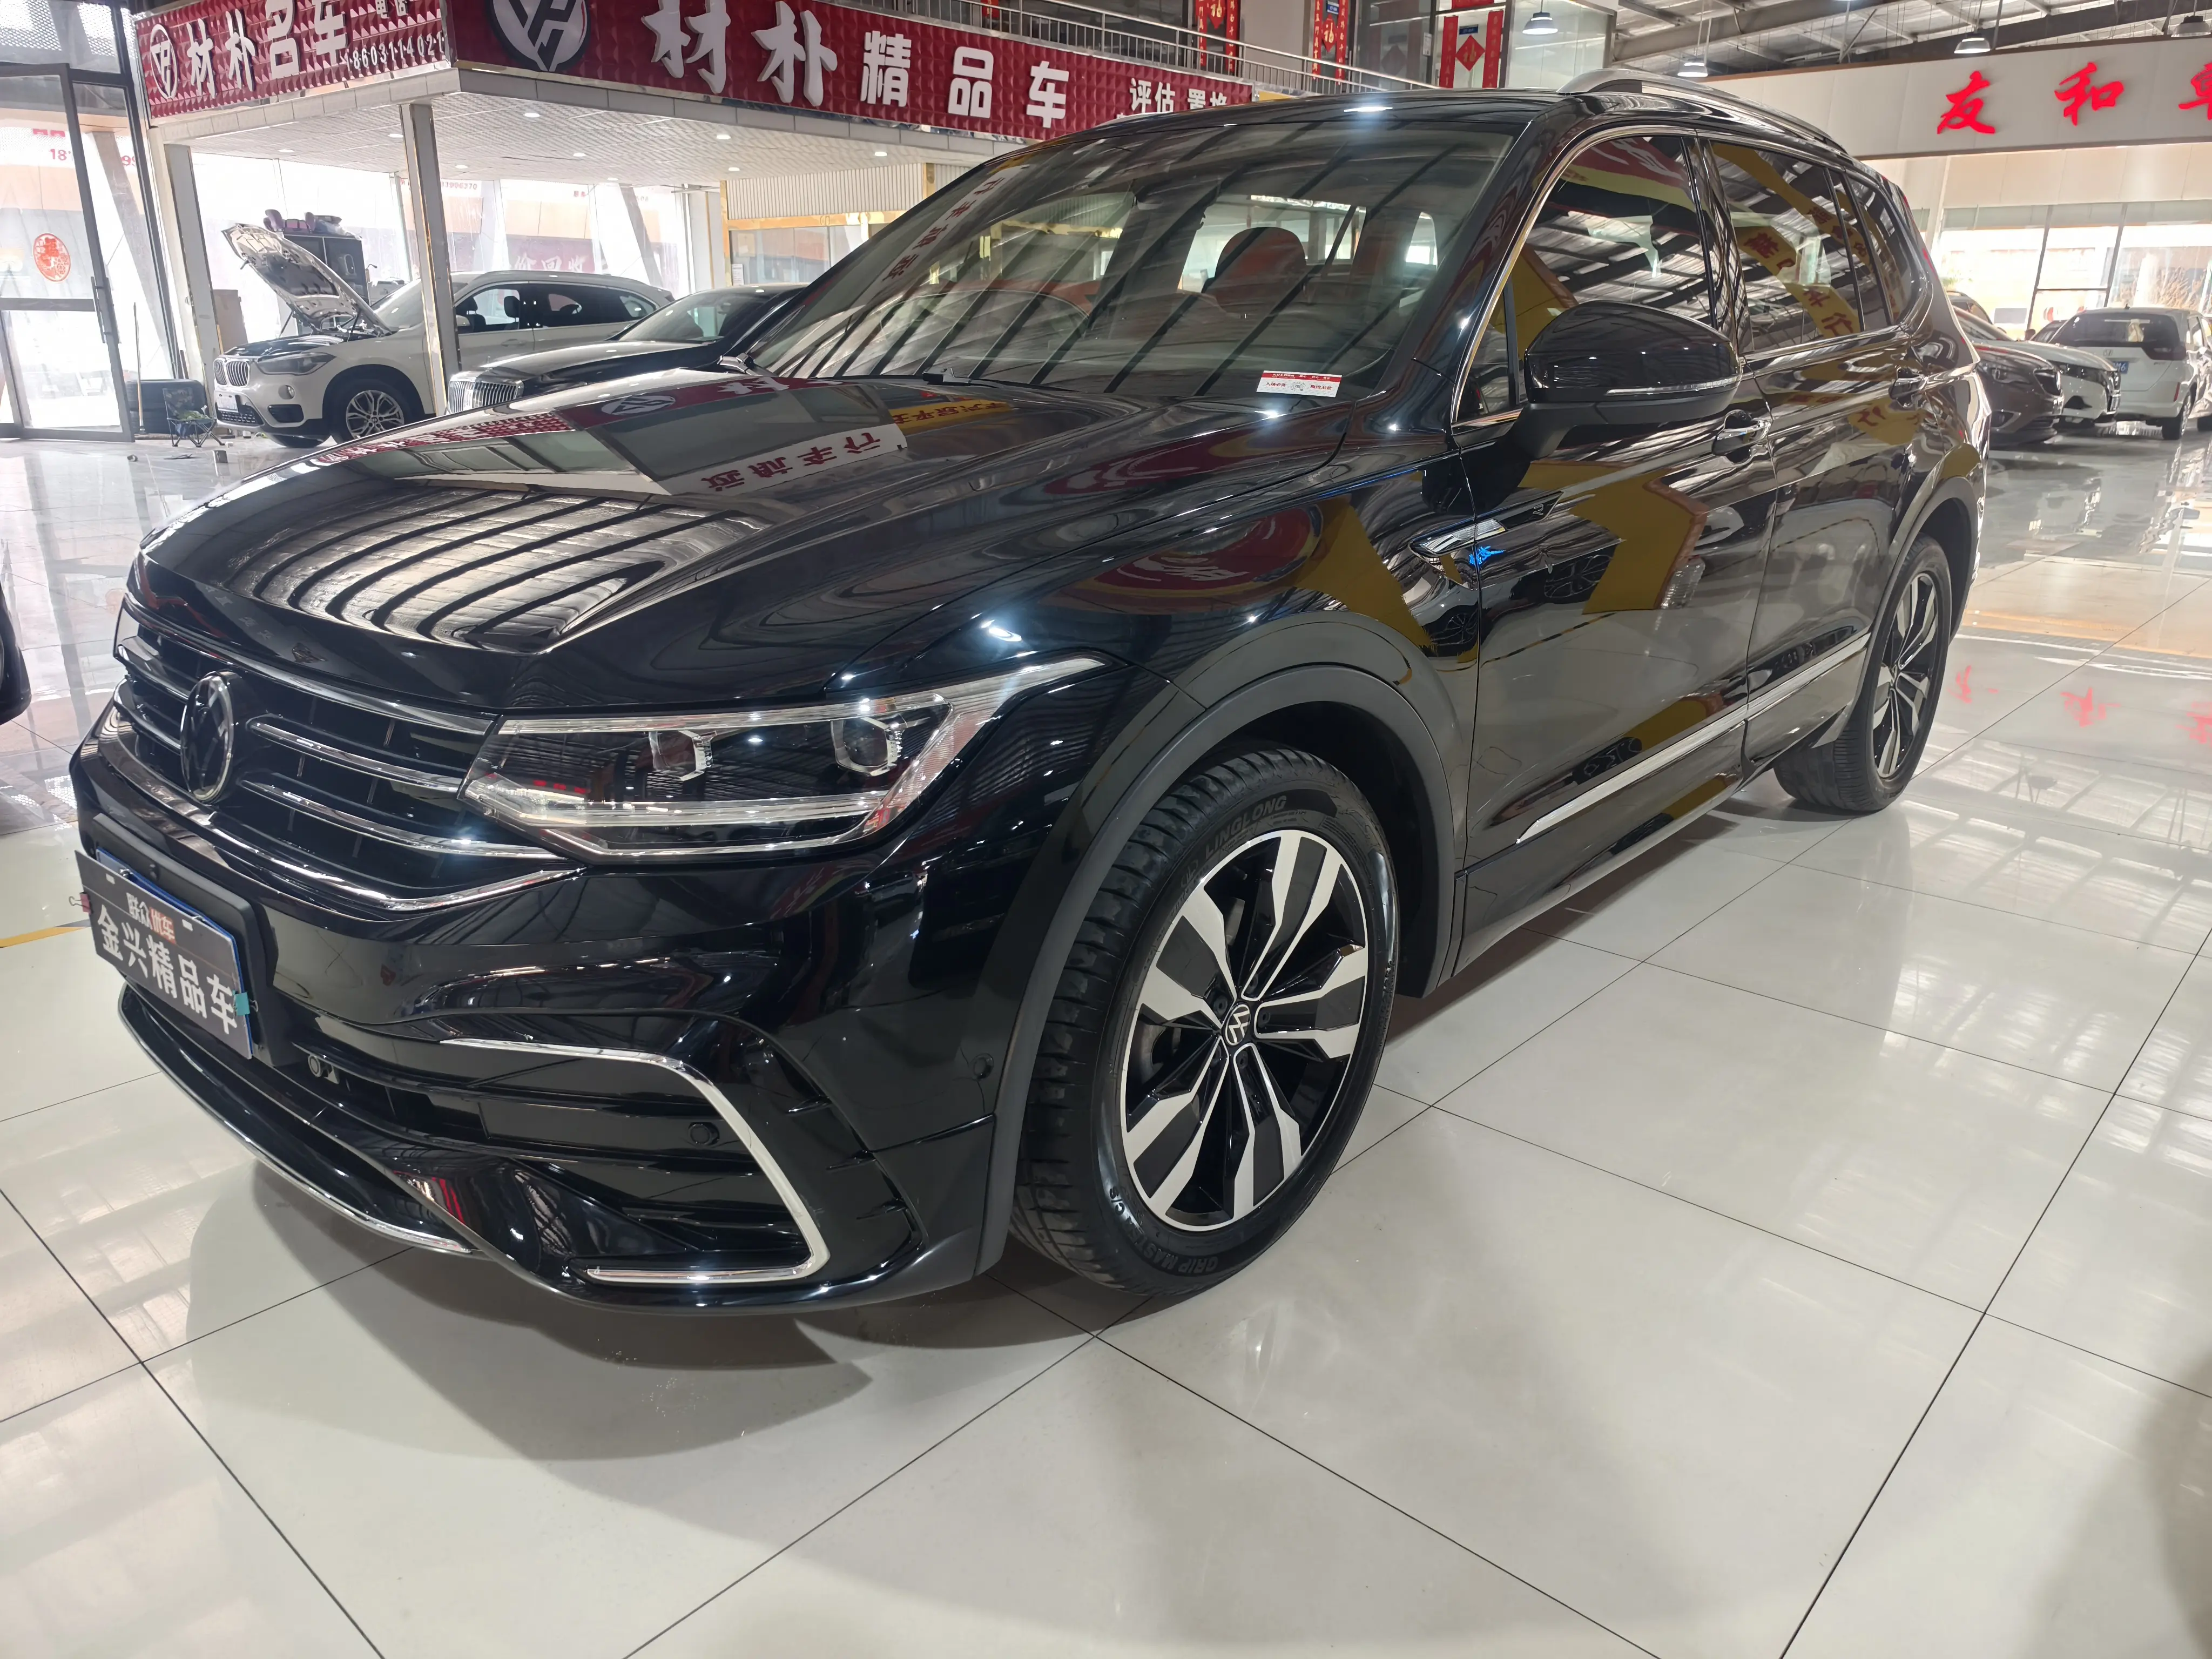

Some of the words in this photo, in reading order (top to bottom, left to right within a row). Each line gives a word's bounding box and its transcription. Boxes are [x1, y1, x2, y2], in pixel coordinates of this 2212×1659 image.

[342, 31, 444, 72] 18603114021
[1130, 78, 1175, 113] 评估
[1205, 795, 1287, 858] LINGLONG
[98, 904, 237, 1034] 金兴精品车
[1178, 1256, 1219, 1274] GRIP
